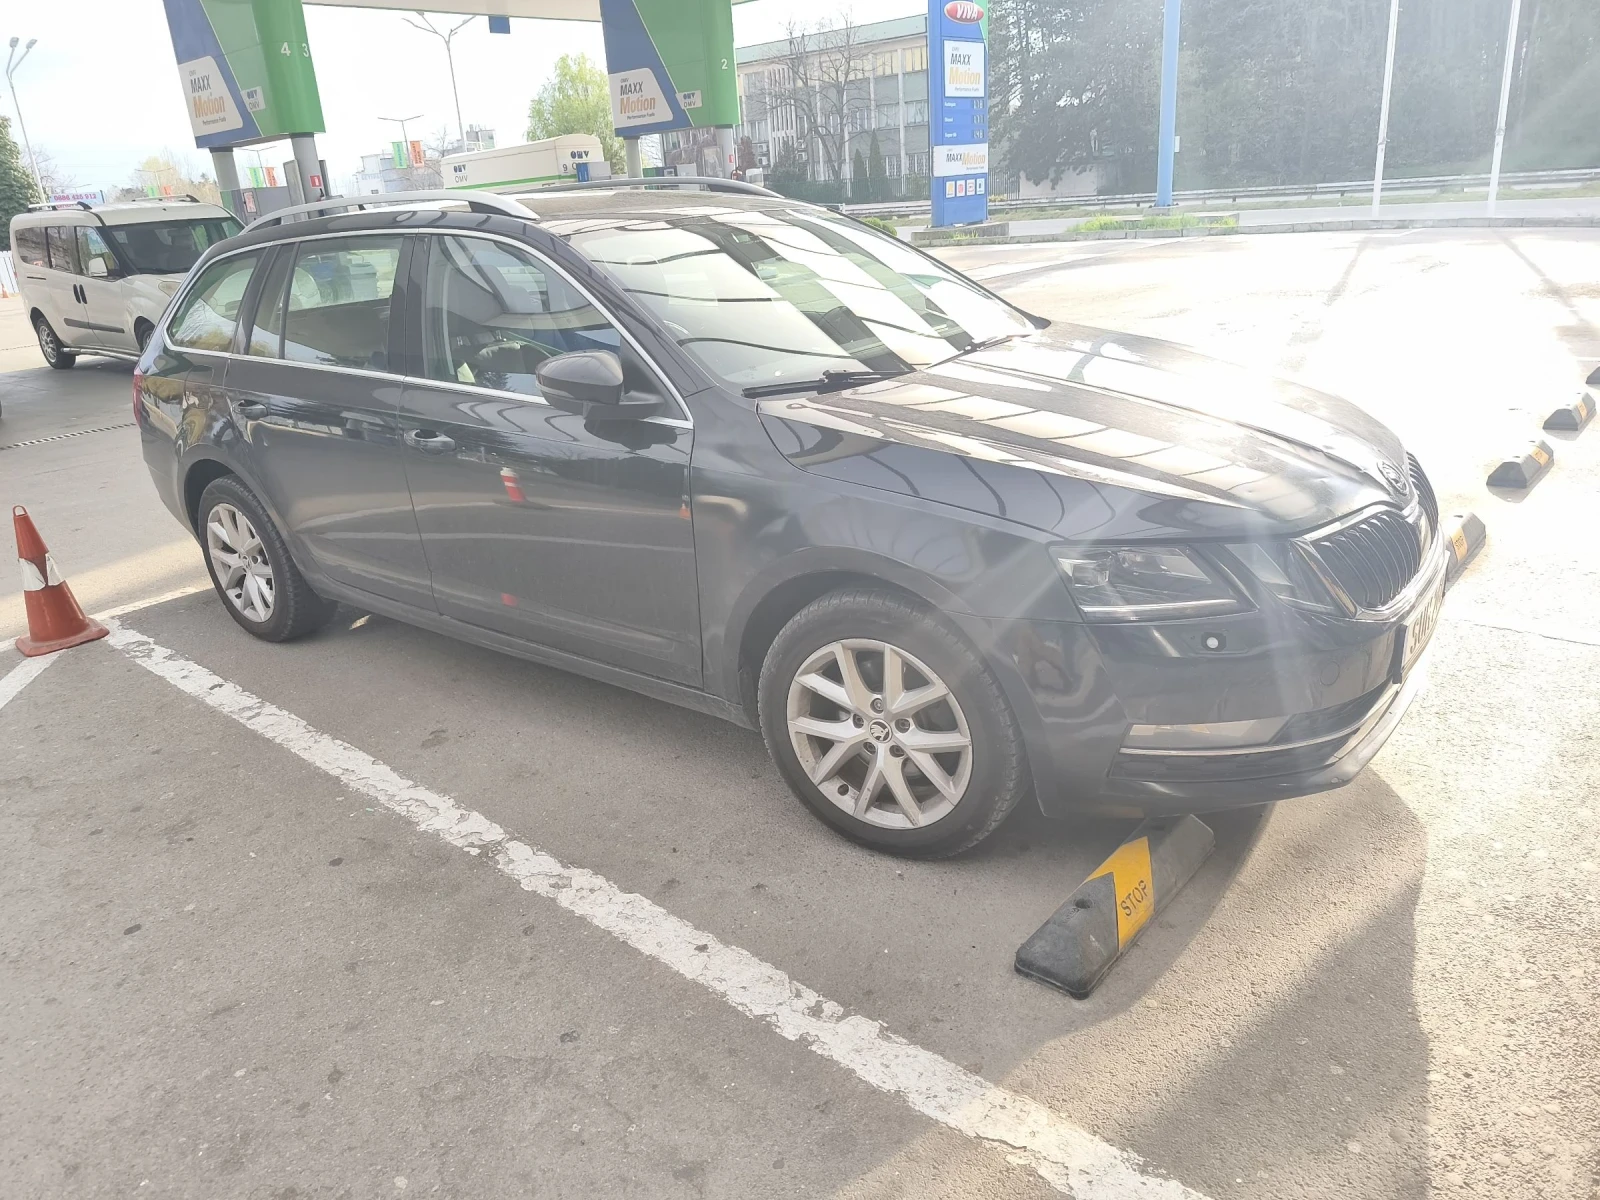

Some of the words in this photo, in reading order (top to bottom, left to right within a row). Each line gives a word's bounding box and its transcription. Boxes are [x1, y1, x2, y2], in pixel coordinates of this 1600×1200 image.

[956, 4, 978, 20] VIVA
[280, 42, 291, 56] 4
[302, 43, 309, 57] 3
[721, 59, 728, 69] 2
[950, 53, 972, 66] MAXX
[949, 67, 981, 85] Motion
[190, 74, 211, 93] MAXX
[620, 81, 643, 96] MAXX
[193, 92, 226, 118] Motion
[620, 95, 656, 115] Motion
[946, 153, 962, 163] MAXX
[962, 152, 986, 166] Motion
[562, 164, 568, 172] 9
[455, 174, 468, 183] OMV
[1120, 880, 1148, 917] STOP
